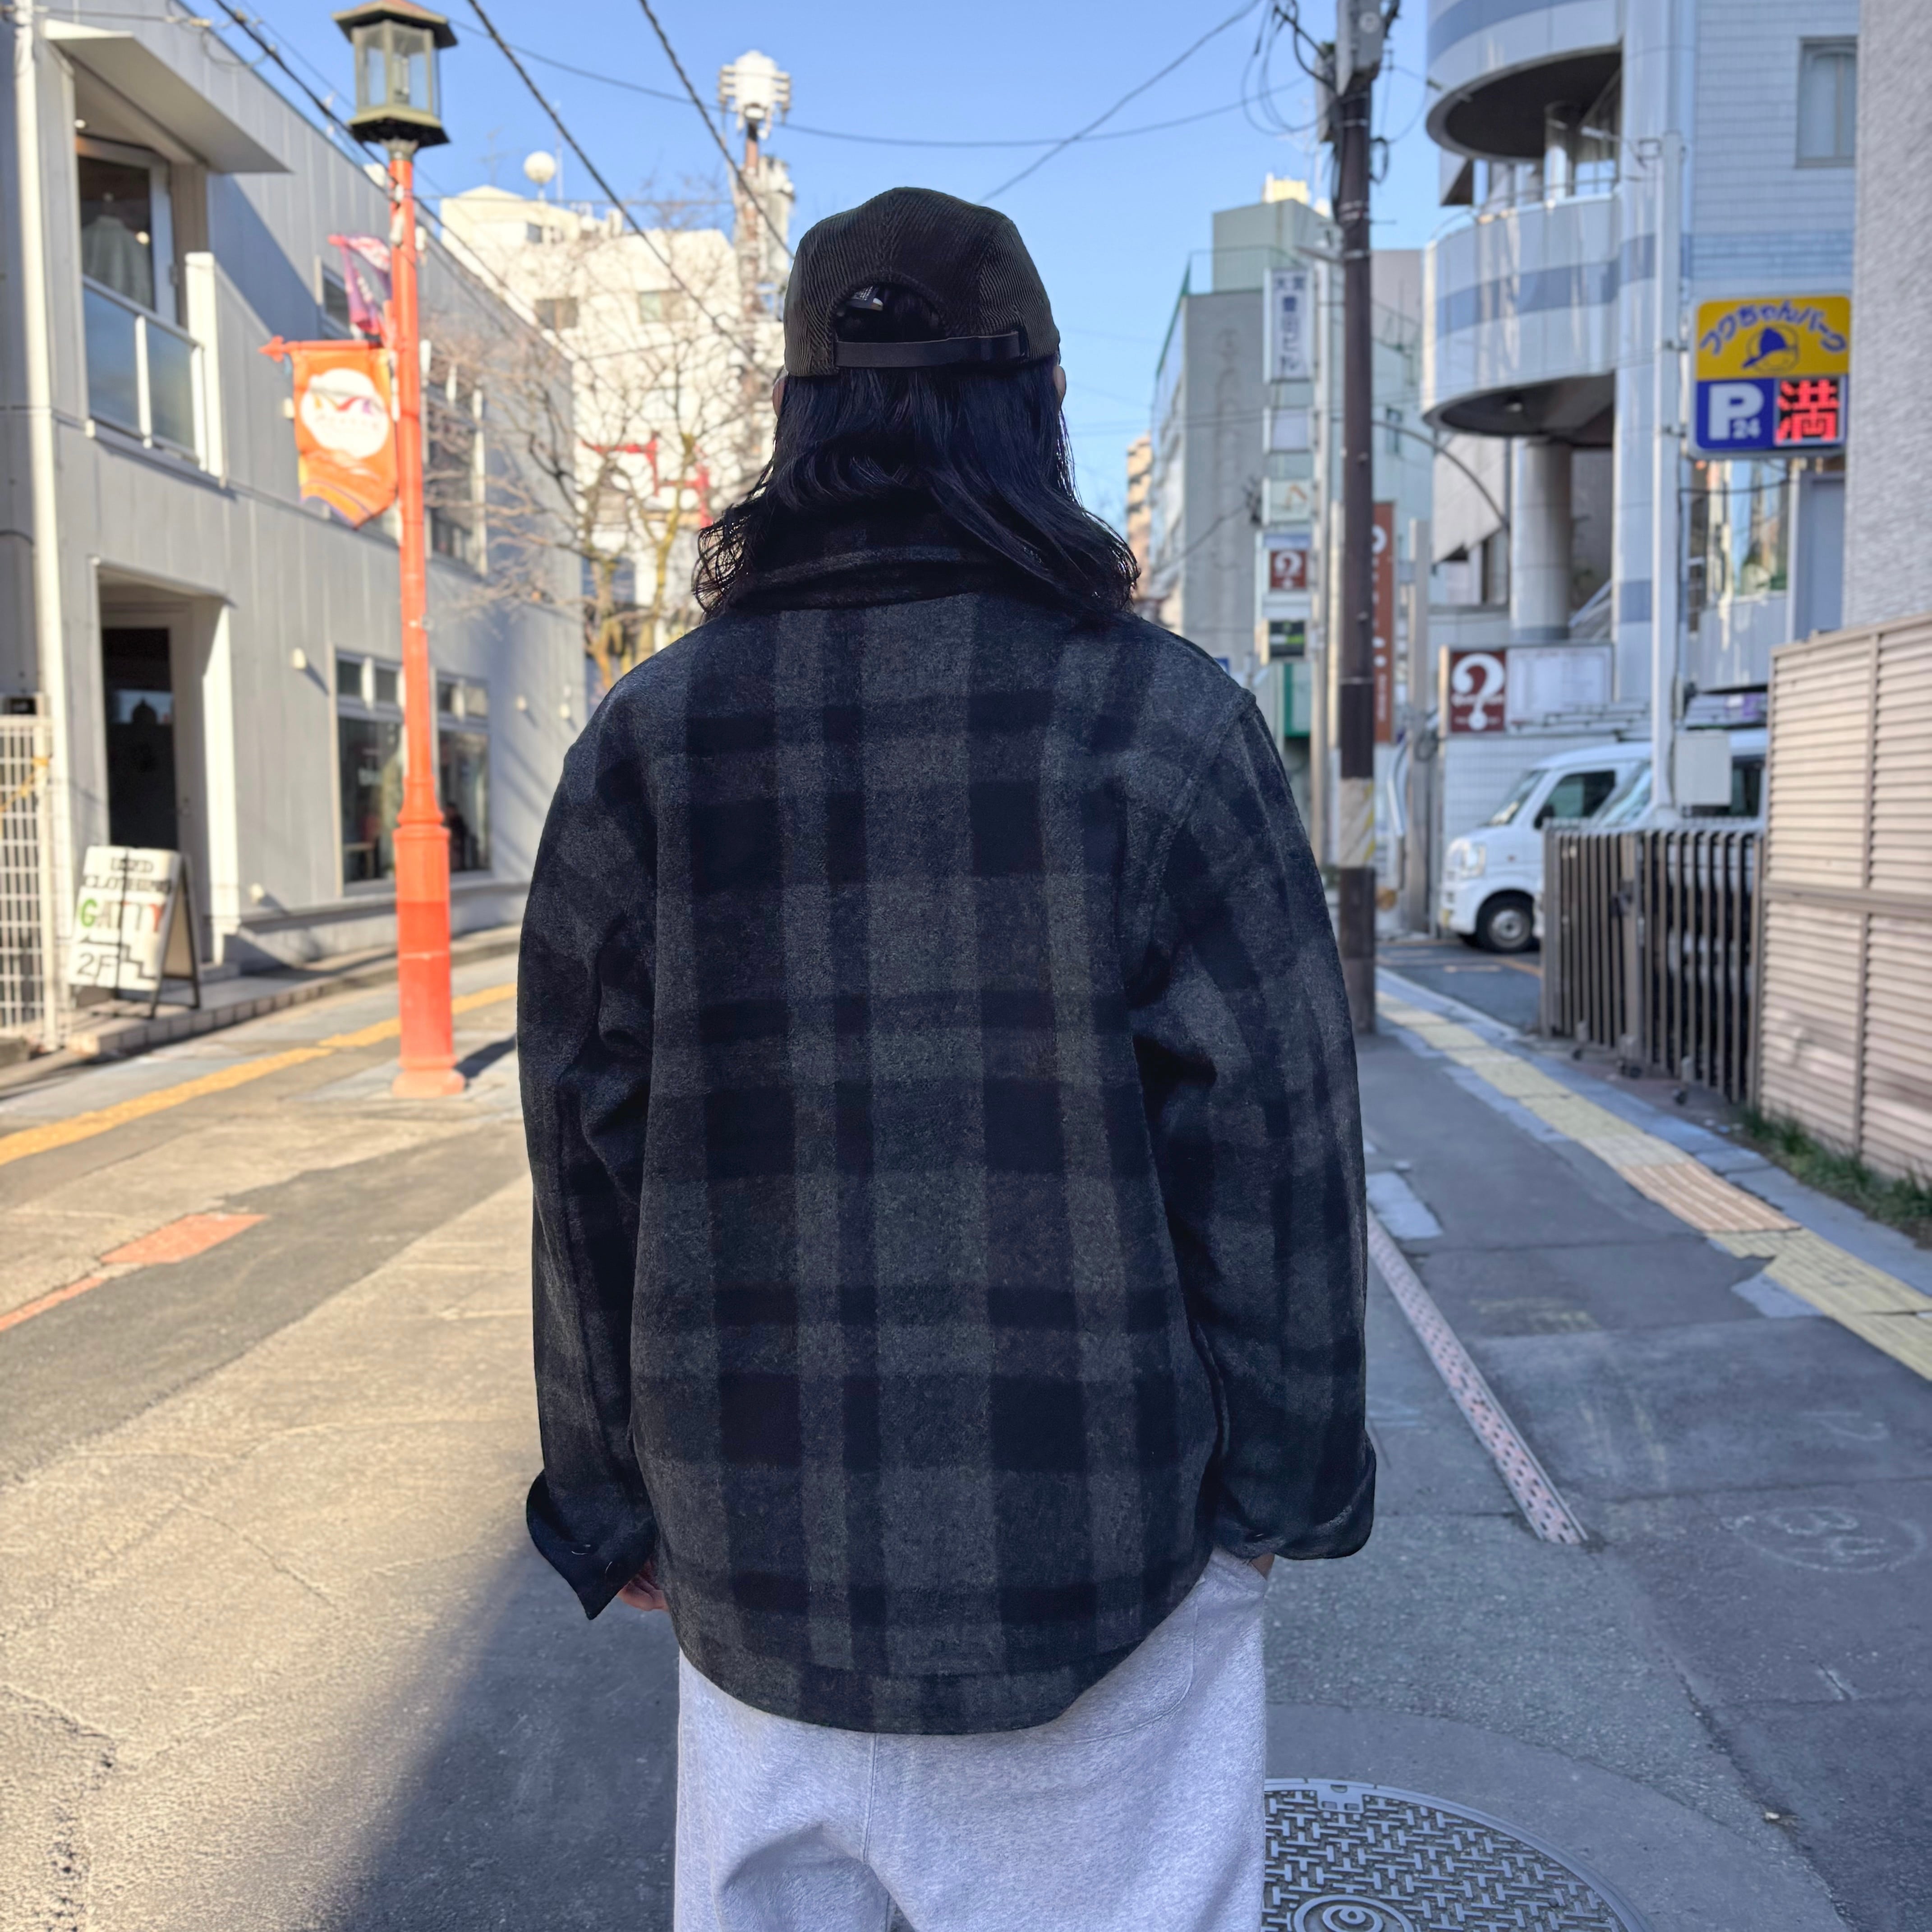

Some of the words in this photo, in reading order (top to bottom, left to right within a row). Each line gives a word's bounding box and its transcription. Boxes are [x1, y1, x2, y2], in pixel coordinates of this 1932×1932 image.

[1699, 300, 1847, 355] フクちゃんパーク
[1775, 379, 1839, 445] 満
[77, 951, 118, 980] 2F
